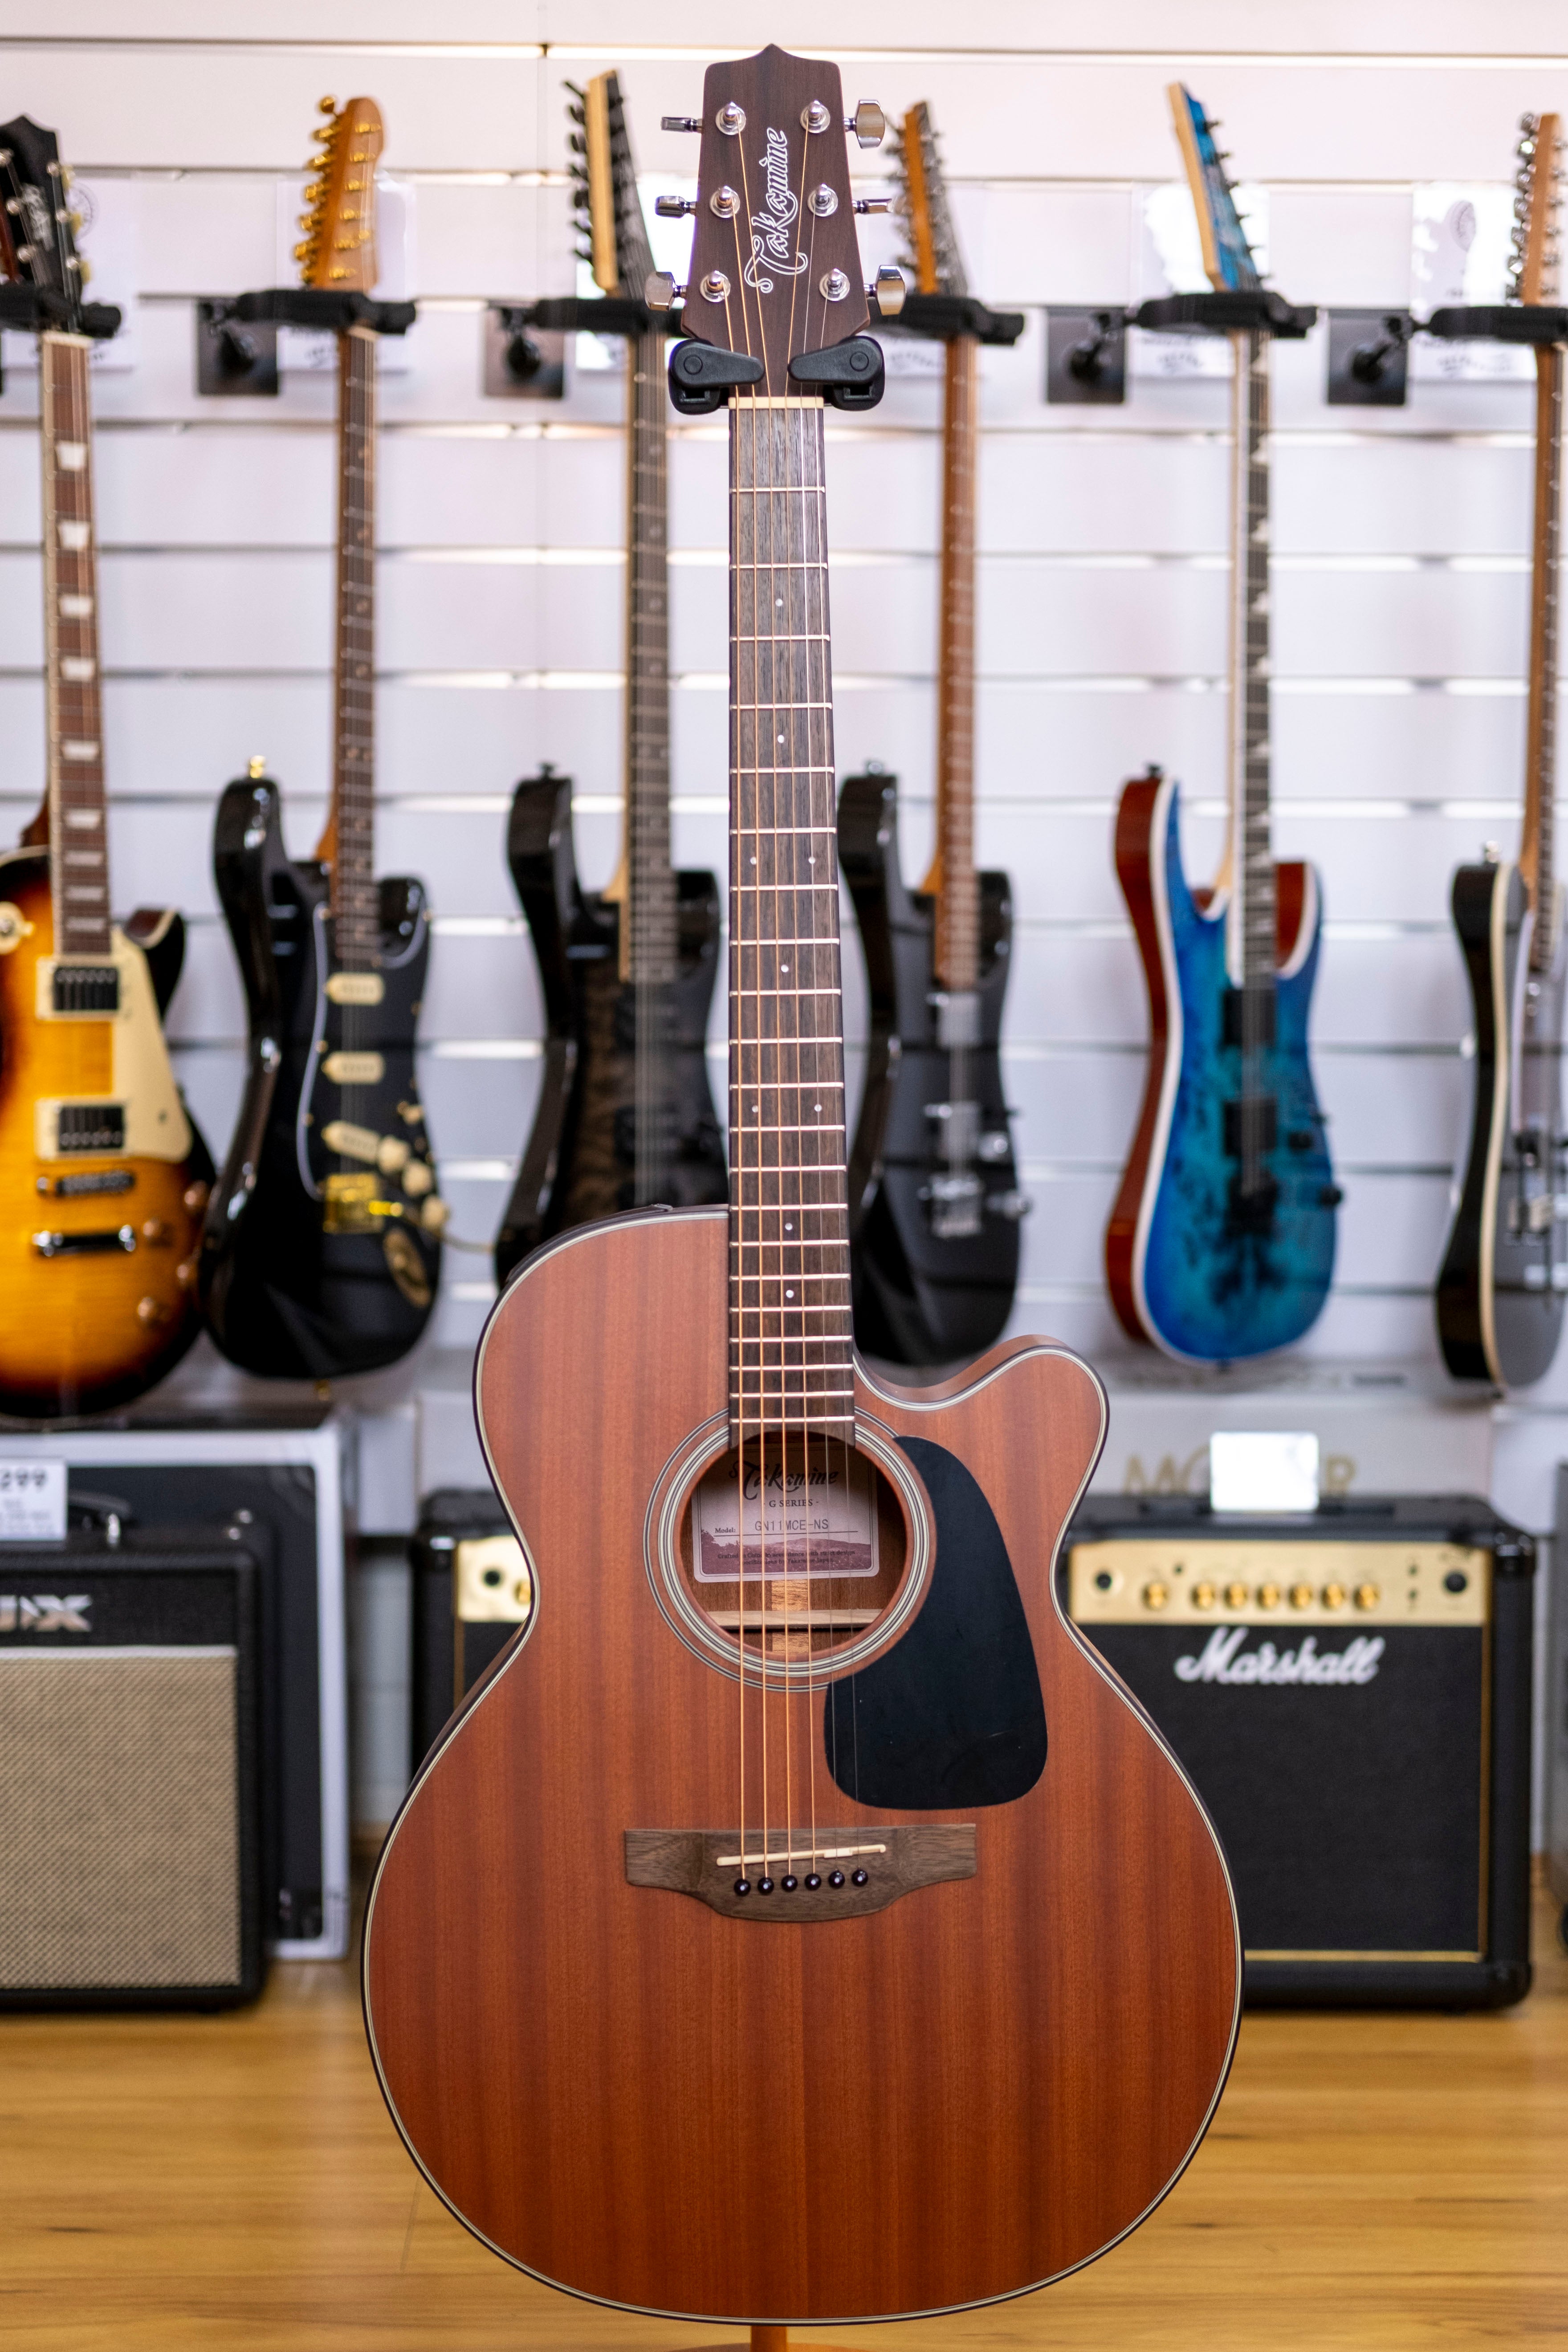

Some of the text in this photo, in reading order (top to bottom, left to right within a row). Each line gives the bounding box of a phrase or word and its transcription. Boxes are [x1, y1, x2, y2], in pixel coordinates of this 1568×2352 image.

[745, 127, 808, 293] Takamine
[729, 1460, 839, 1501] Takamine
[755, 1519, 828, 1531] GN11MCE-NS
[1174, 1625, 1386, 1685] Marshall
